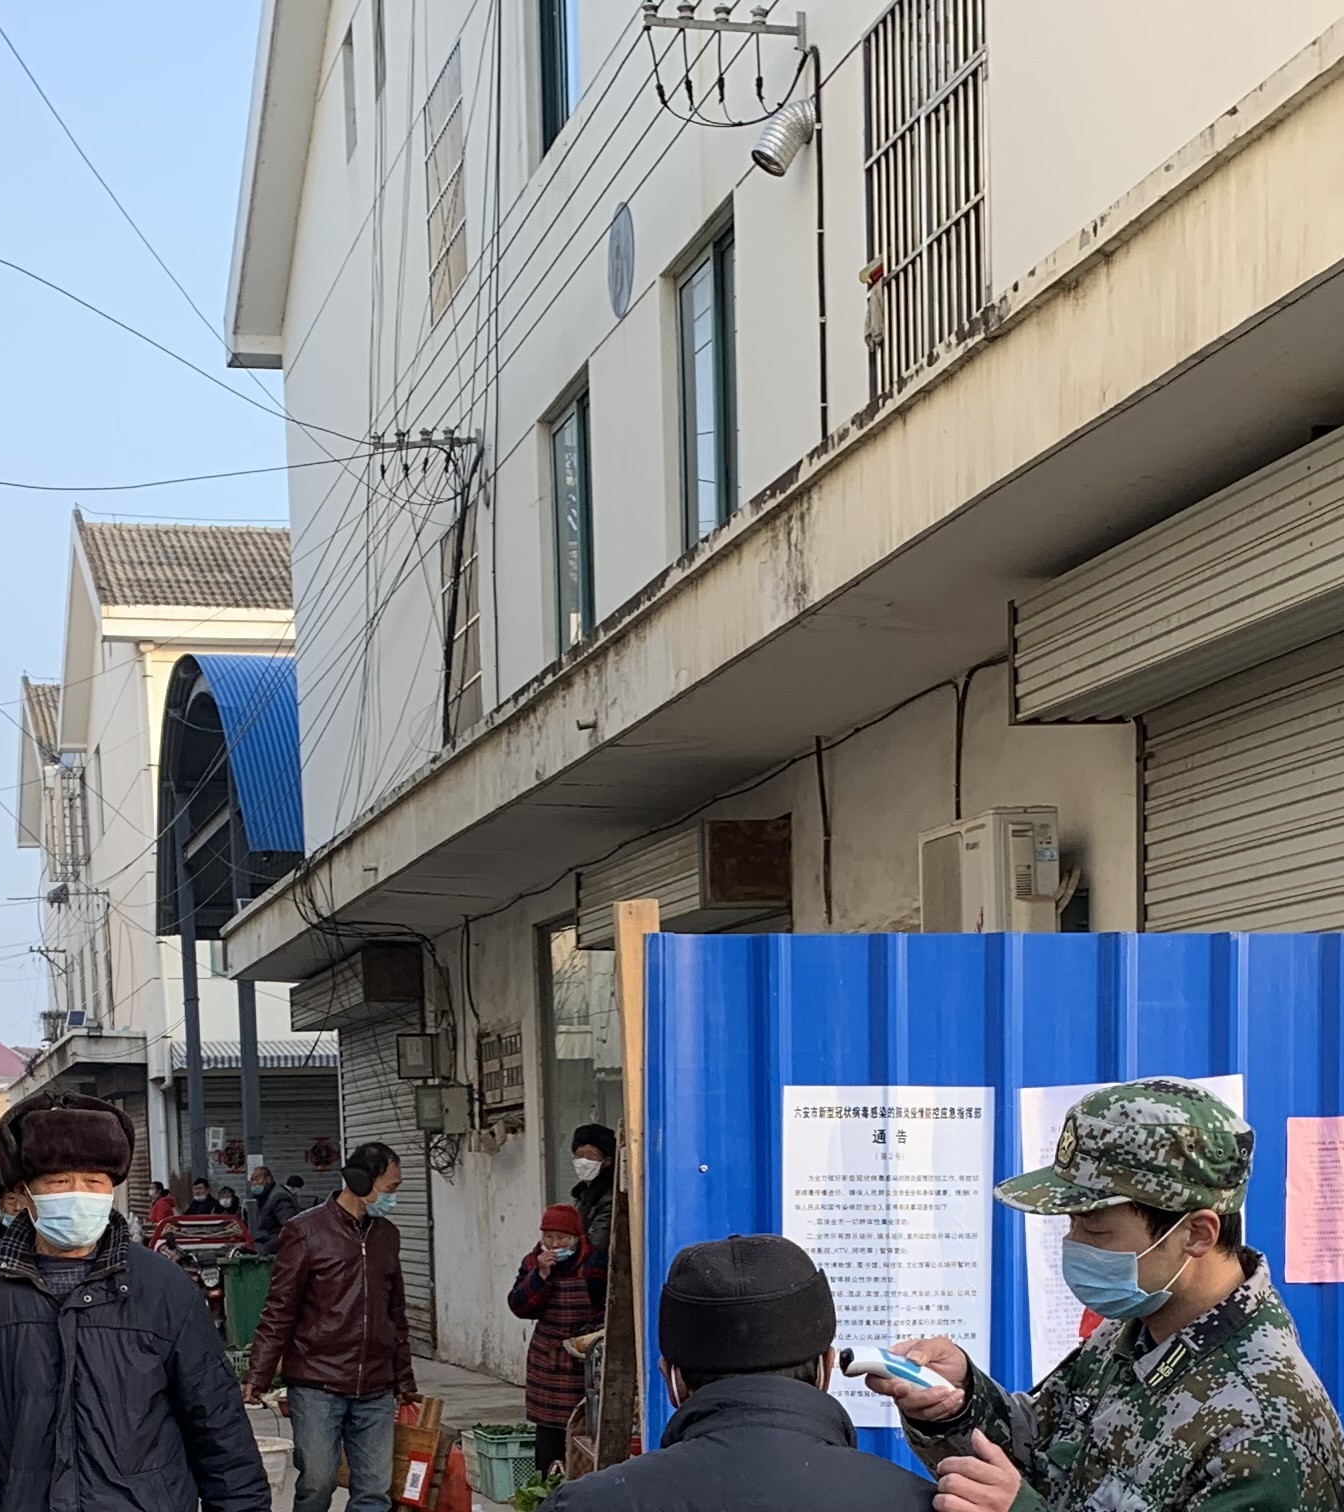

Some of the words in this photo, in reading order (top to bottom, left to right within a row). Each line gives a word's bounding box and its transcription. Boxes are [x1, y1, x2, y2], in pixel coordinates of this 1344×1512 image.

[794, 1106, 982, 1120] 六安市新型冠状病毒感染的肺炎疫情防控应急指挥部
